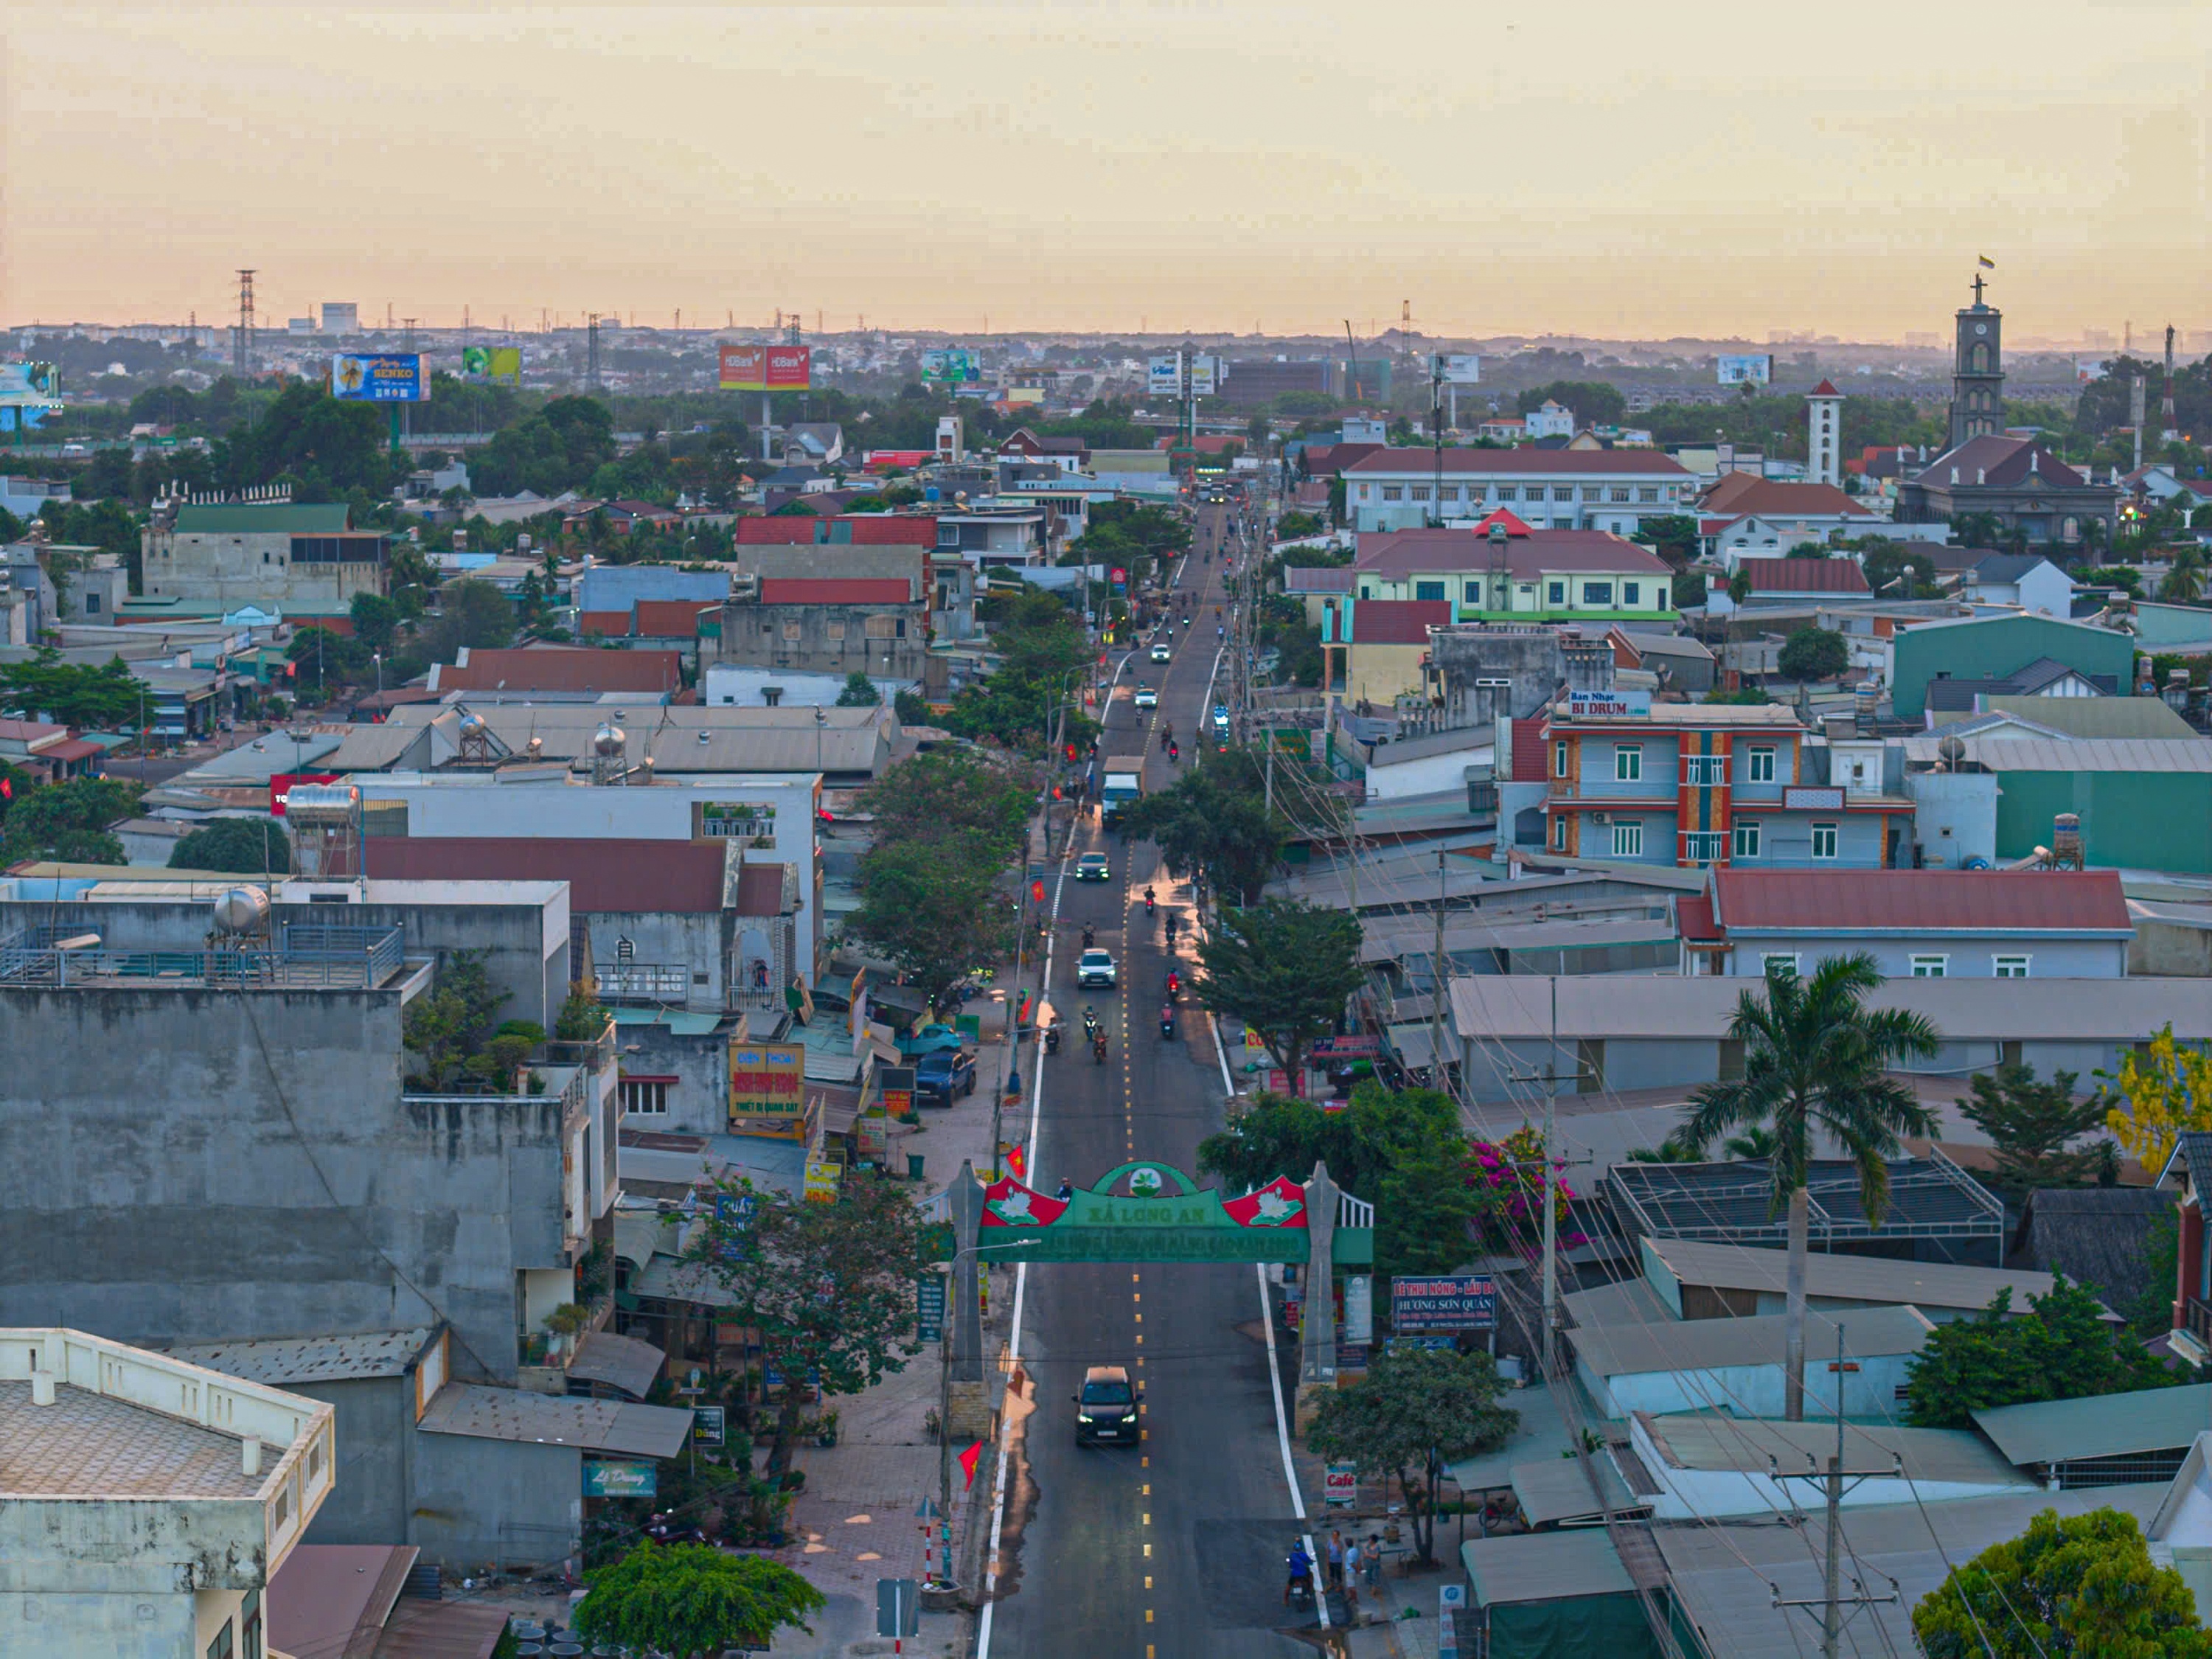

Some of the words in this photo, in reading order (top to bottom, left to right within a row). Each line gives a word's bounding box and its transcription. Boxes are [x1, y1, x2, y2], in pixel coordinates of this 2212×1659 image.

[771, 356, 799, 367] HDBank
[1571, 692, 1589, 700] Ban
[1571, 703, 1585, 714] BI
[1588, 703, 1627, 714] DRUM
[1122, 1207, 1174, 1223] LONG
[1180, 1207, 1206, 1222] AN
[1406, 1283, 1428, 1295] THUI
[1429, 1279, 1457, 1295] NÓNG
[1399, 1298, 1436, 1311] HƯƠNG
[1438, 1298, 1459, 1310] SƠN
[1462, 1296, 1492, 1311] QUÁN
